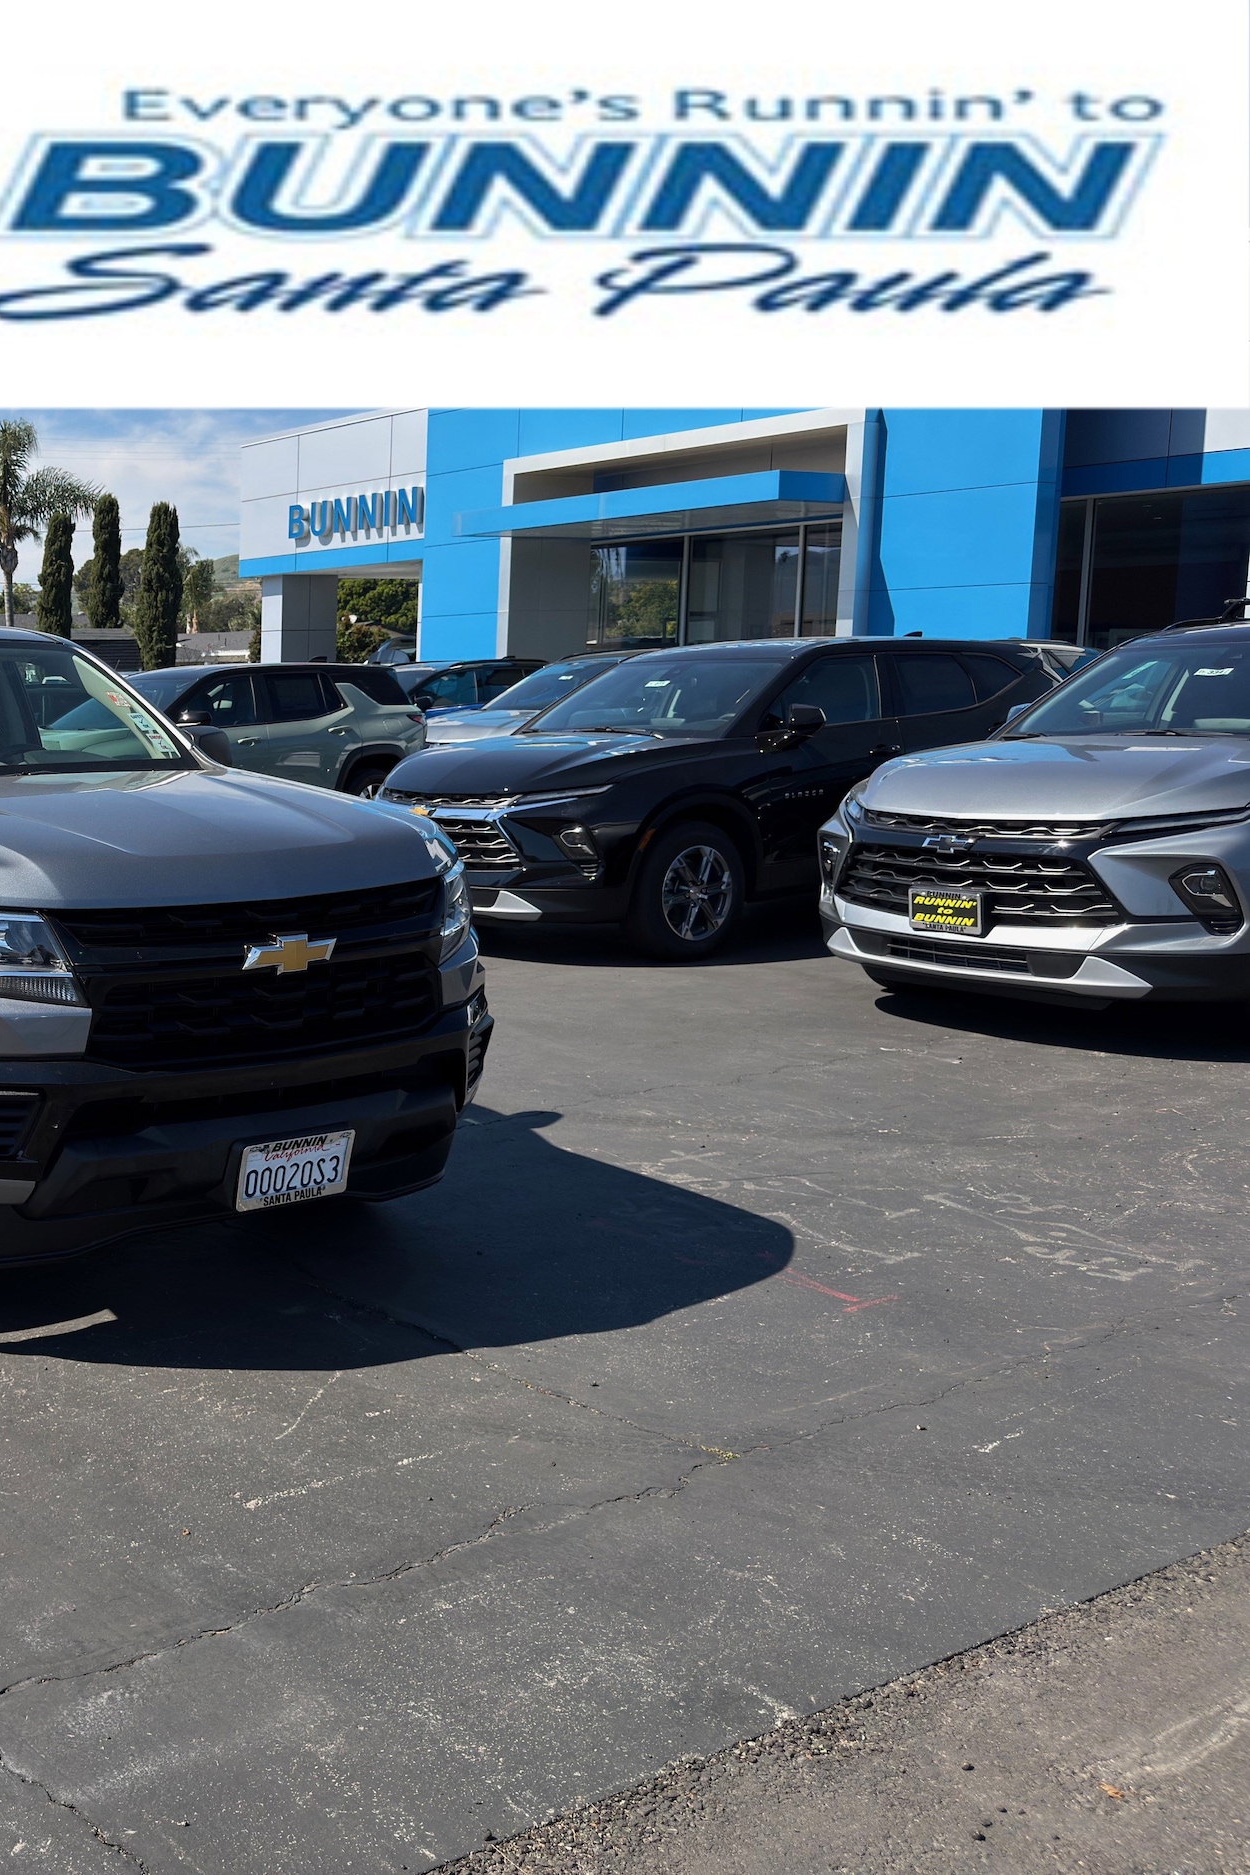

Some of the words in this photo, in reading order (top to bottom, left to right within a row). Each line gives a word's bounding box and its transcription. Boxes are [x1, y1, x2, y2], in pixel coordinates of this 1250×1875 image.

[288, 486, 424, 540] BUNNIN
[913, 896, 978, 909] RUNNIN'
[937, 906, 954, 915] to
[913, 913, 975, 927] BUNNIN
[271, 1134, 329, 1153] BUNNIN
[244, 1155, 341, 1199] 00020S3
